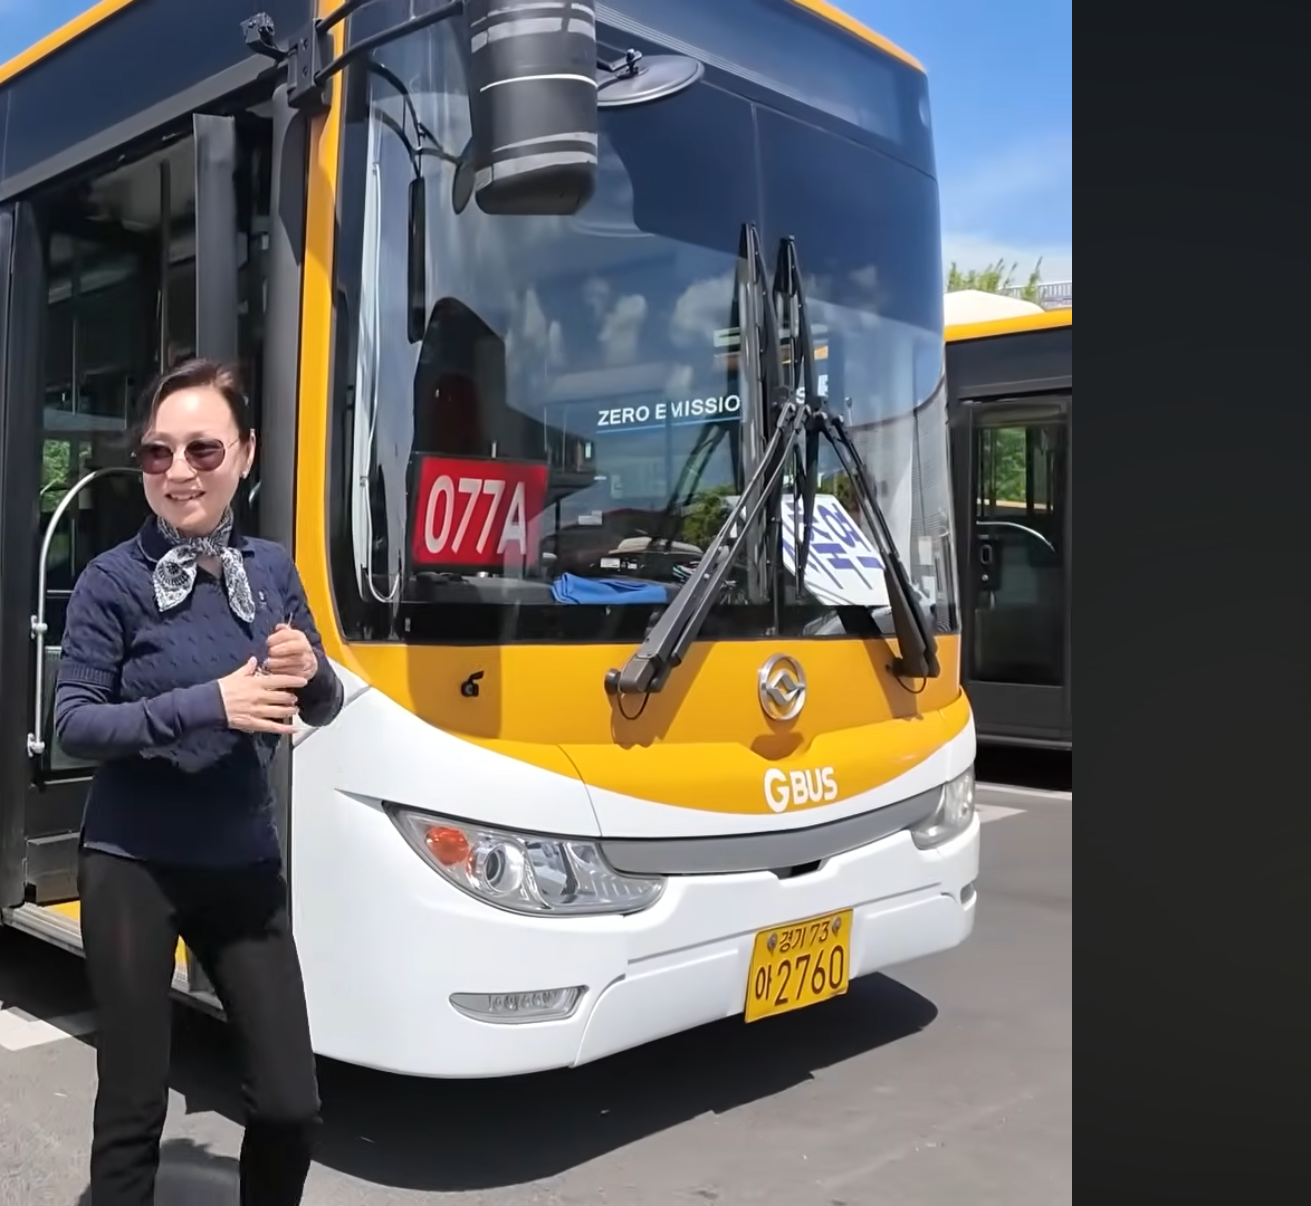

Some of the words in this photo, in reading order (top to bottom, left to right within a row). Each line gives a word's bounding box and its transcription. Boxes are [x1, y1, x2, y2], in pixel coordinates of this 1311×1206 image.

[597, 404, 650, 427] ZERO
[655, 394, 741, 420] EMISSIO
[424, 474, 527, 555] 077A
[779, 927, 807, 954] 경기
[809, 919, 831, 947] 73
